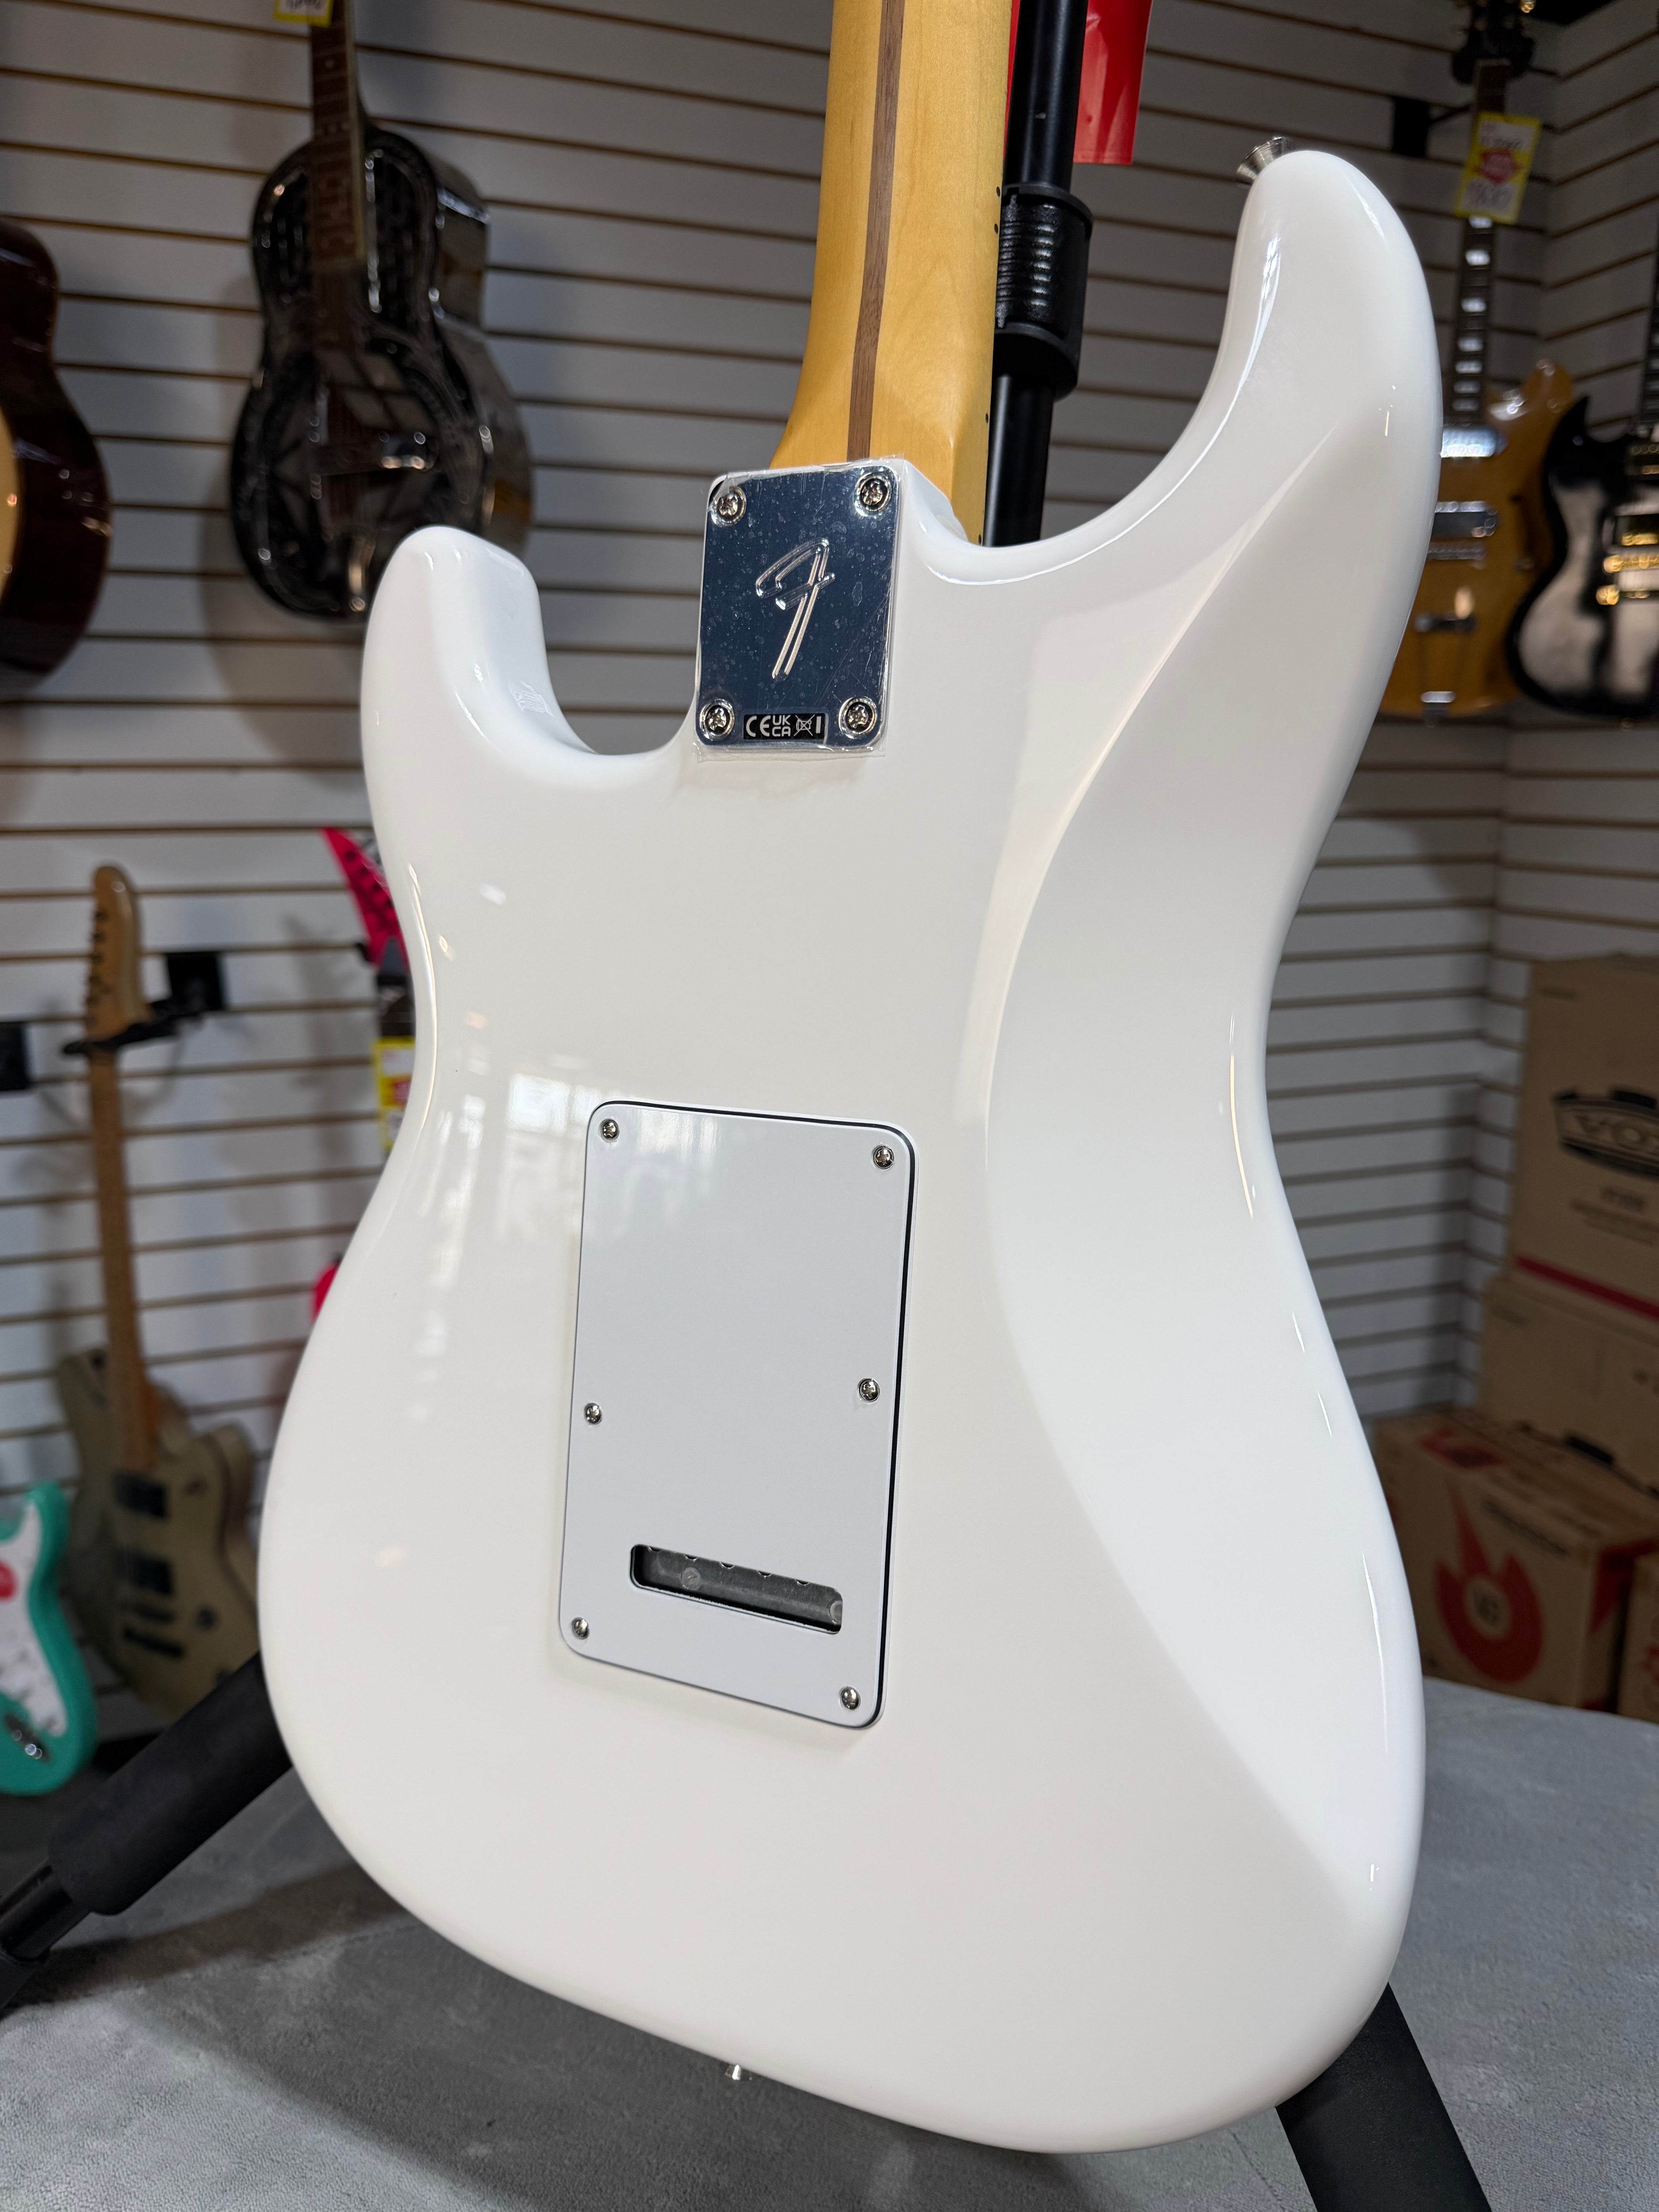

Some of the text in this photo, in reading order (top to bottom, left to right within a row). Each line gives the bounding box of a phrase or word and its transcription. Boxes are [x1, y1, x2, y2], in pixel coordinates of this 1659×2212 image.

[773, 715, 791, 725] UK
[746, 715, 771, 737] CE
[772, 726, 791, 737] CA
